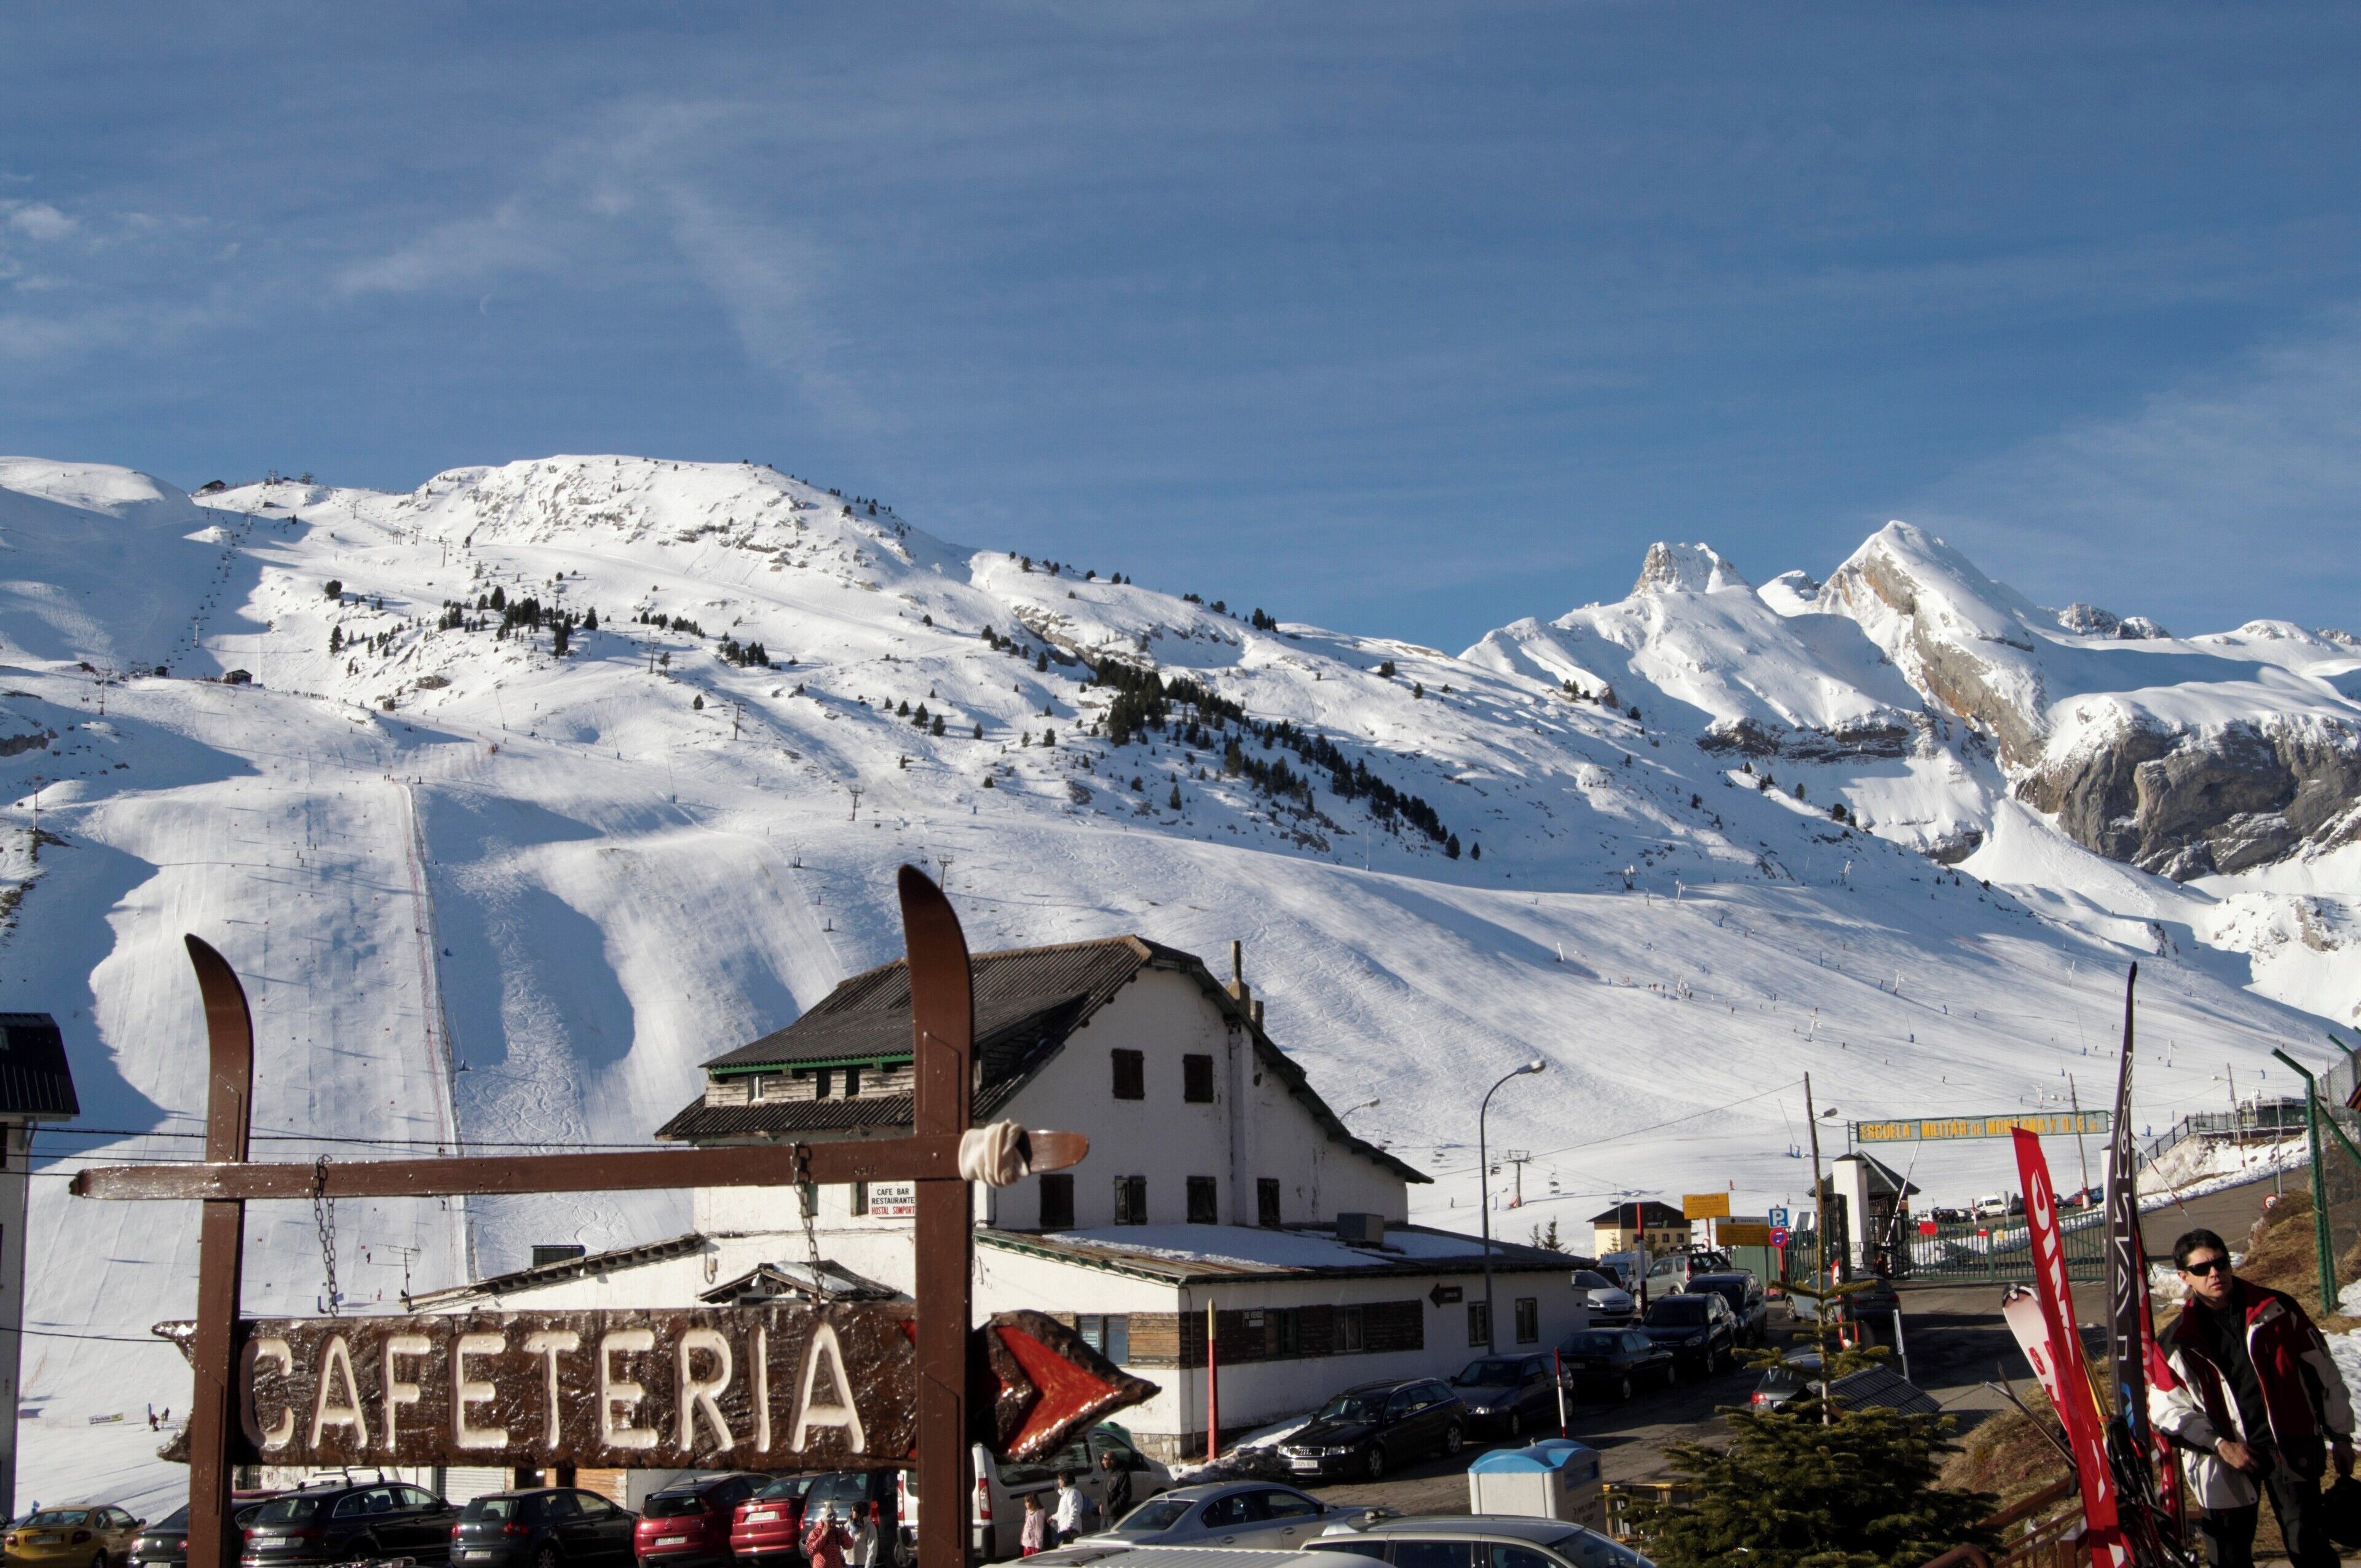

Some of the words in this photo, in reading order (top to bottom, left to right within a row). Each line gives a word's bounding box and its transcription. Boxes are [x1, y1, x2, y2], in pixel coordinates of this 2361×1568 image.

[1861, 1124, 1911, 1141] ESCUELA
[1921, 1121, 1968, 1137] MILITAR
[872, 1206, 889, 1215] HOSTAL
[1772, 1210, 1785, 1225] P
[242, 1322, 864, 1453] CAFETERIA
